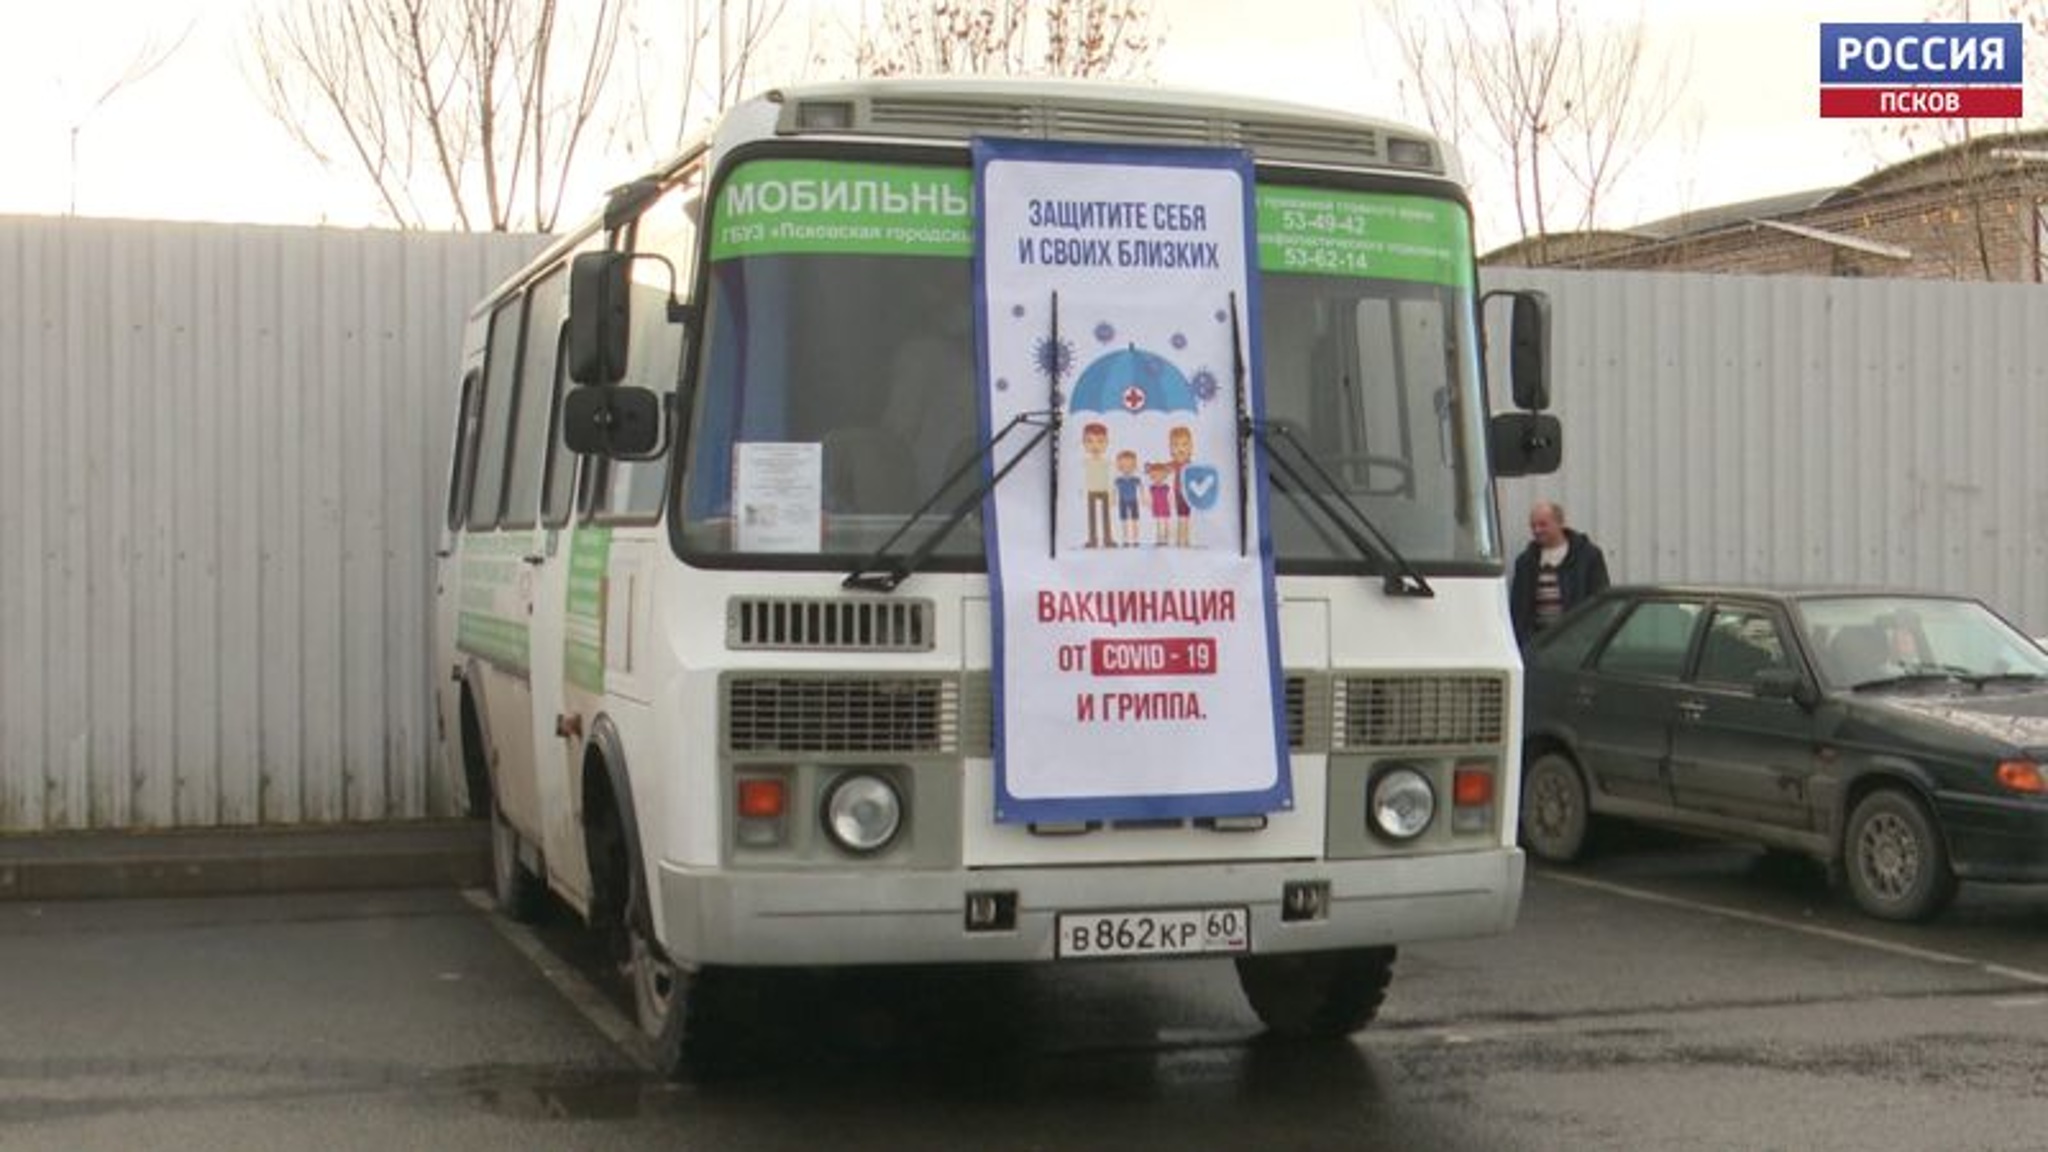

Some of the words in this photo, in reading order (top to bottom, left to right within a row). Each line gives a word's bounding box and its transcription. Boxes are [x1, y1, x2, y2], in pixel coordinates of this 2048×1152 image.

[1028, 199, 1147, 231] ЗАЩИТИТЕ
[1153, 203, 1206, 231] СЕБЯ
[1018, 238, 1034, 265] И
[1040, 239, 1113, 267] СВОИХ
[1118, 241, 1219, 269] БЛИЗКИХ
[1037, 589, 1236, 627] ВАКЦИНАЦИЯ
[1058, 645, 1086, 671] ОТ
[1103, 643, 1165, 669] COVID
[1187, 643, 1210, 668] 19
[1077, 693, 1095, 722] И
[1102, 692, 1207, 721] ГРИППА.
